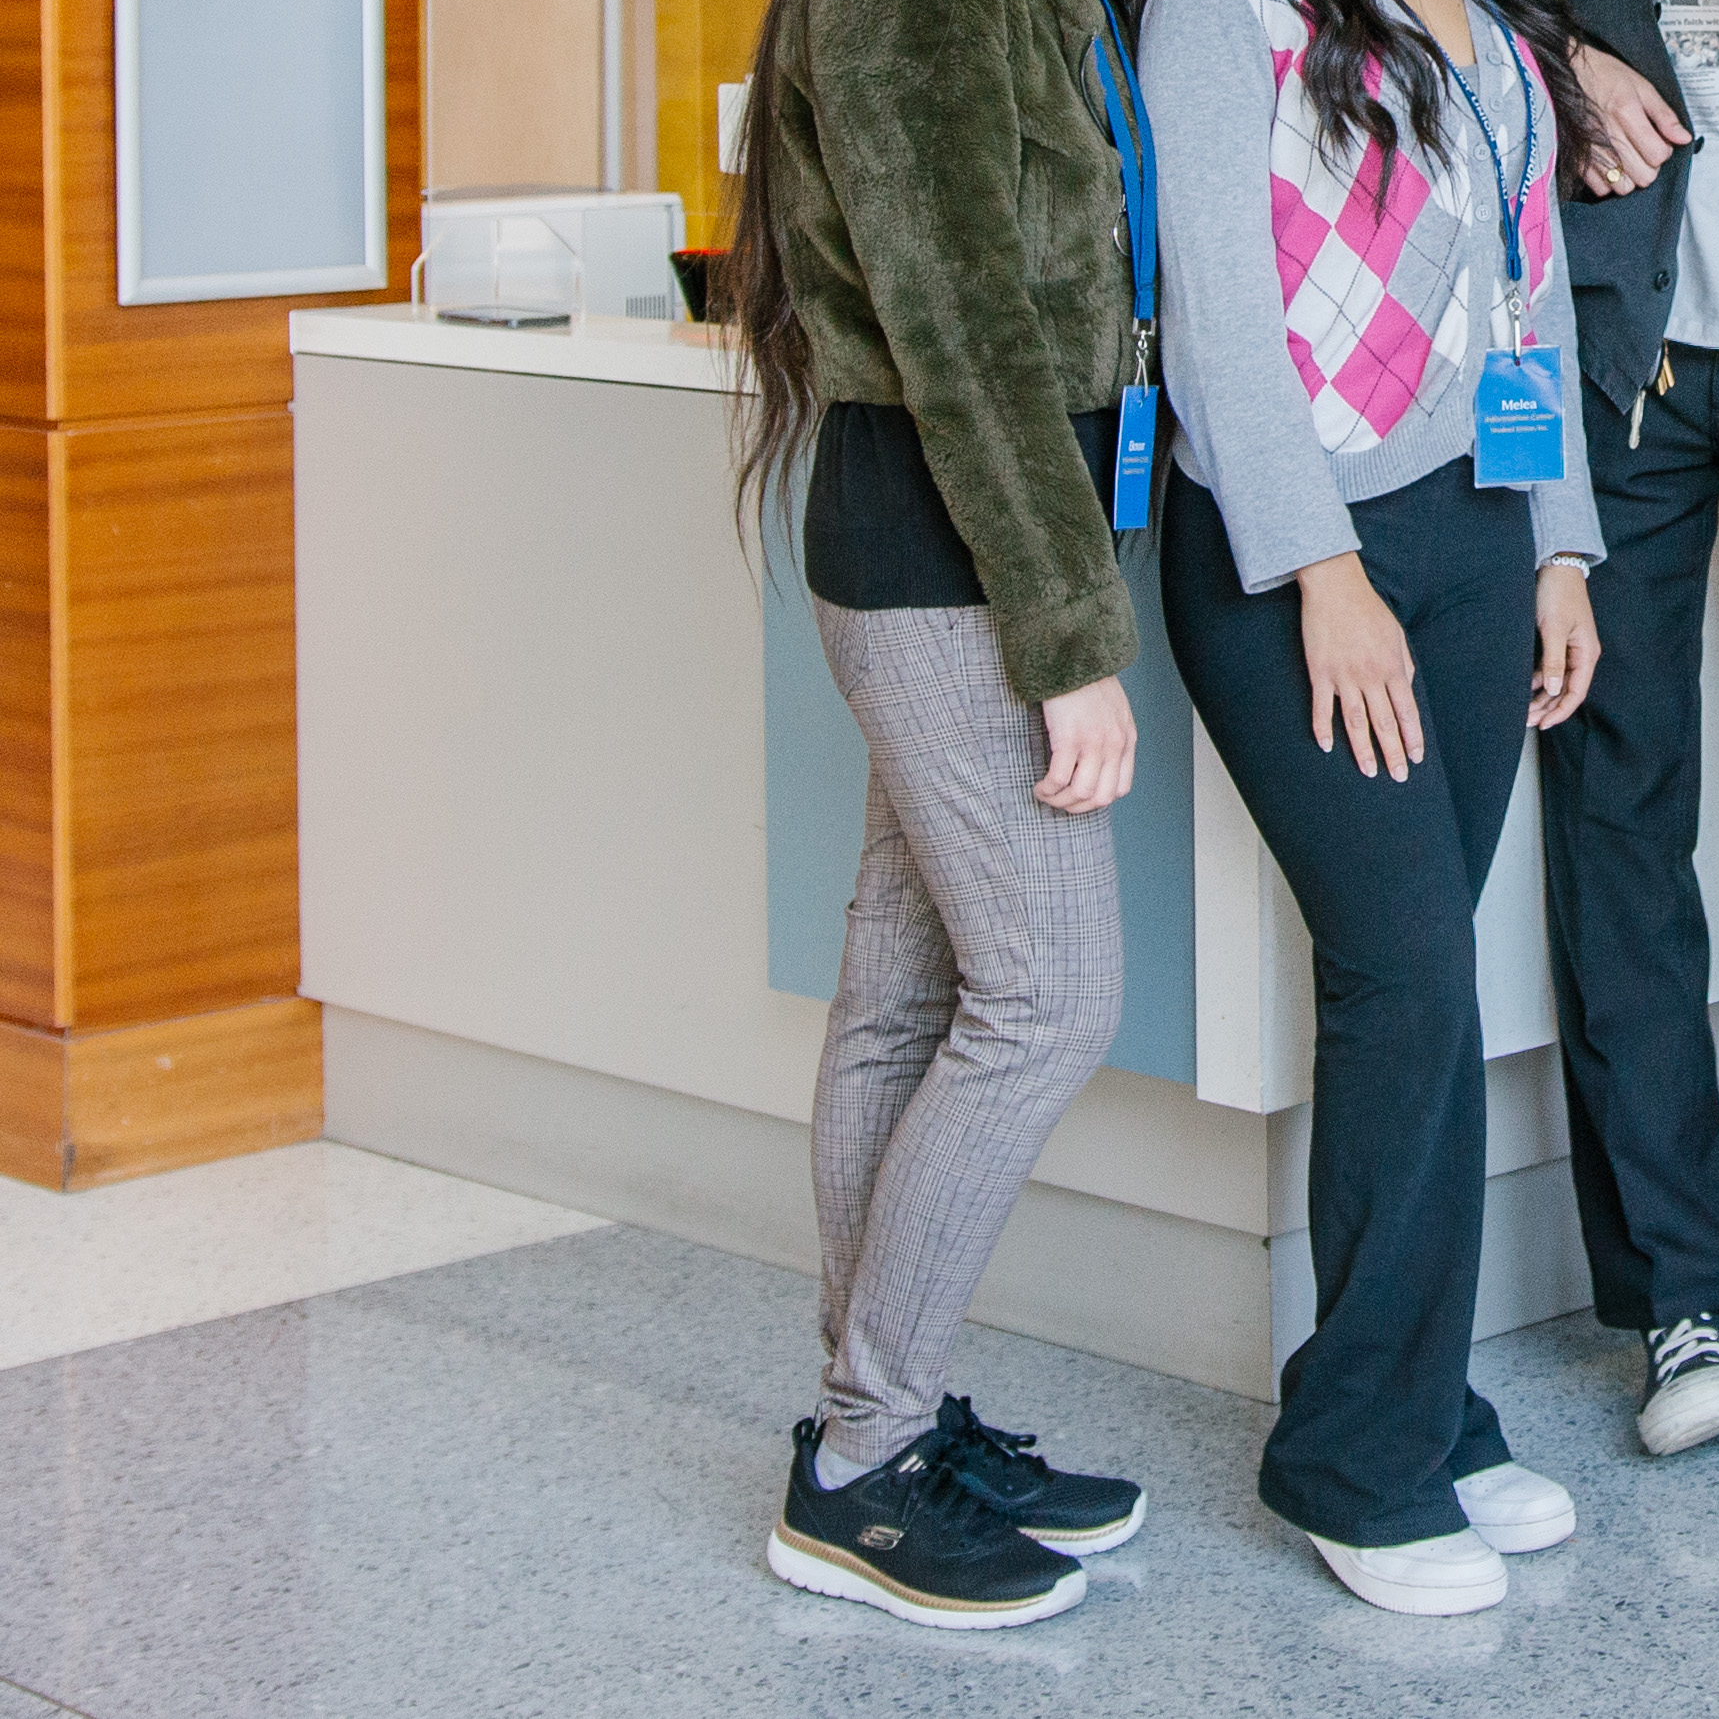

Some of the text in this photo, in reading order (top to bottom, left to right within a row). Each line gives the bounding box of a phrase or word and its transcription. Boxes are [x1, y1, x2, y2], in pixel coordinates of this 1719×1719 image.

[1471, 95, 1496, 142] UNION
[1519, 86, 1538, 205] STUDENT UNION
